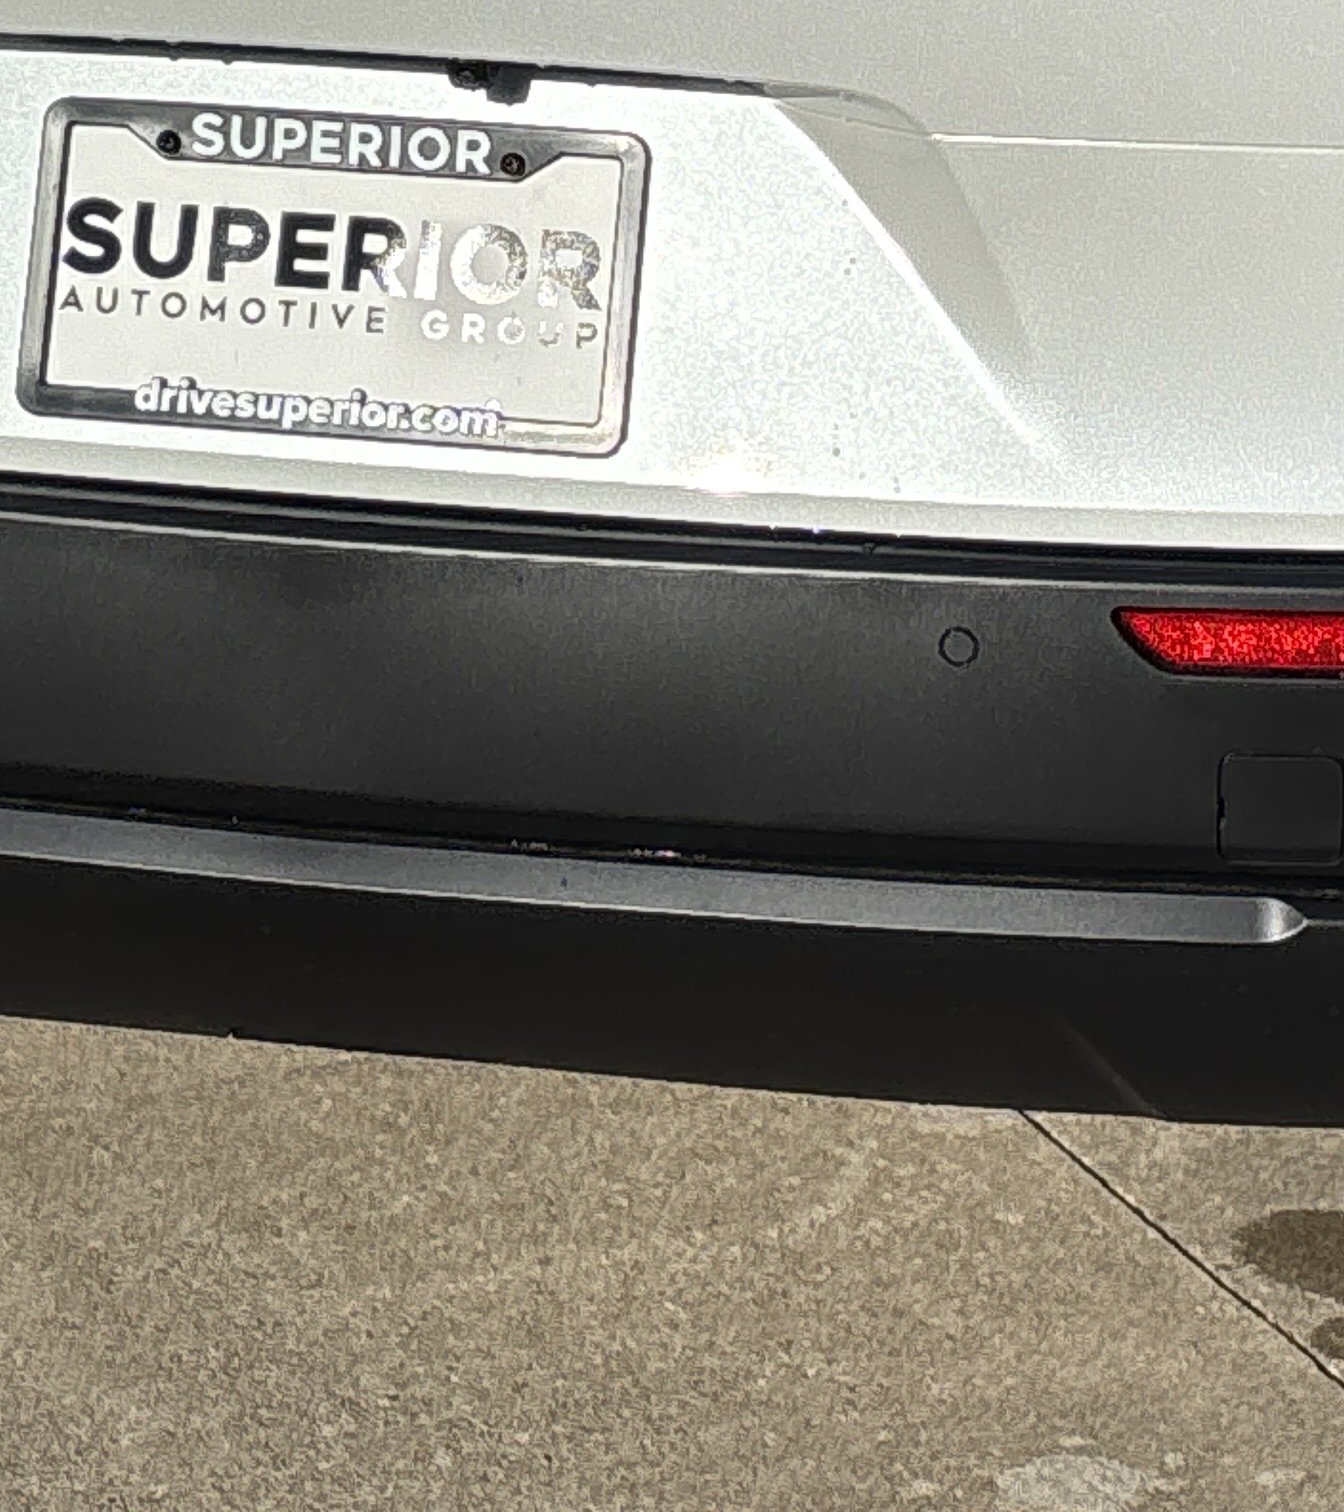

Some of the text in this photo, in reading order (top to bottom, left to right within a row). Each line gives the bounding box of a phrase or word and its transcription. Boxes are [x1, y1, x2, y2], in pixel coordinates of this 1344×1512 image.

[190, 111, 494, 176] SUPERIOR
[61, 196, 603, 312] SUPERIOR
[58, 284, 599, 350] AUTOMOTIVE GROUP
[133, 376, 503, 438] drivesuperior.com
